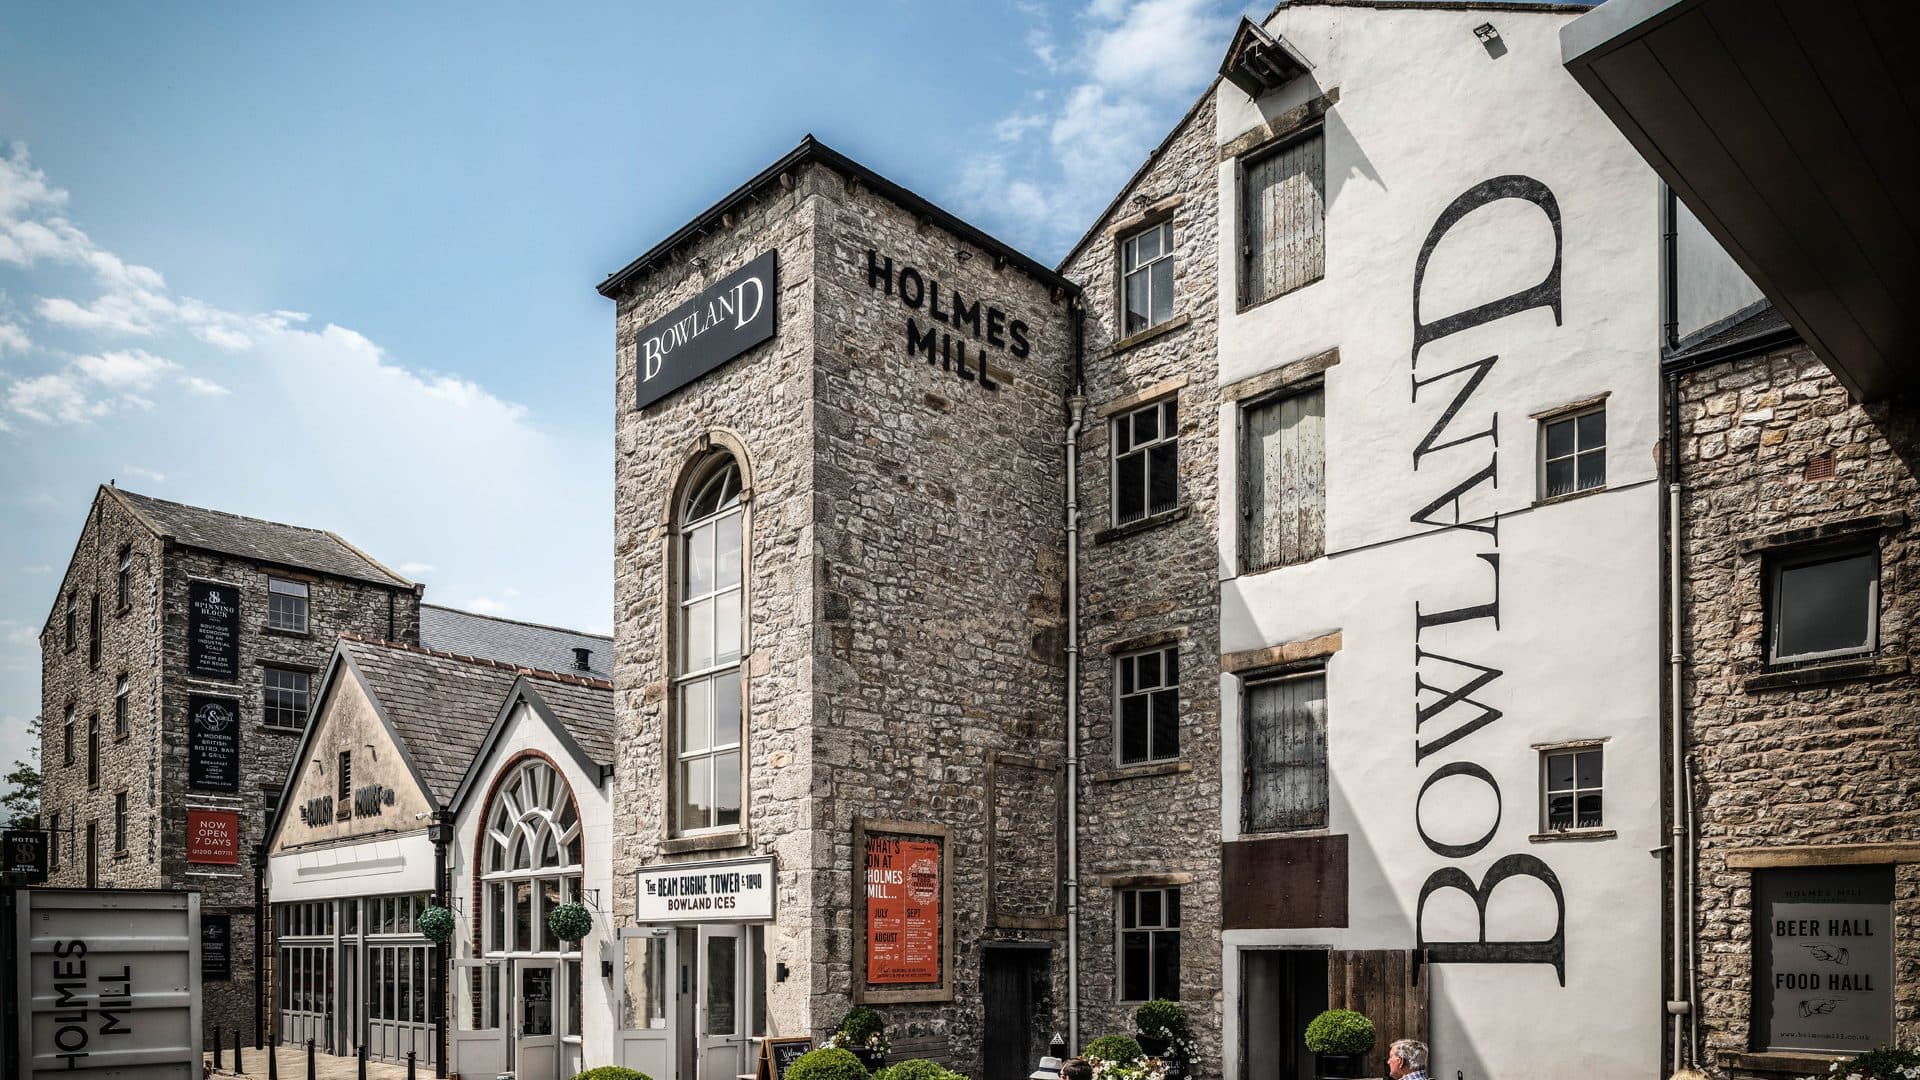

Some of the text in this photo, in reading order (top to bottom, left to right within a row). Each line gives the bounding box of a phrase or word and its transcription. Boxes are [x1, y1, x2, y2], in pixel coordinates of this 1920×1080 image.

[867, 248, 1031, 360] HOLMES
[642, 276, 764, 384] BOWLAND
[906, 317, 997, 391] MILL
[1410, 174, 1565, 988] BOWLAND
[201, 607, 228, 618] BLOCK
[200, 820, 226, 829] NOW
[11, 836, 40, 844] HOTEL
[198, 829, 228, 838] OPEN
[204, 837, 232, 847] DAYS
[867, 838, 901, 854] WHAT'S
[868, 853, 893, 869] ON AT
[657, 876, 678, 897] BEAM
[680, 874, 707, 896] ENGINE
[709, 872, 740, 895] TOWER
[867, 868, 903, 885] HOLMES
[667, 896, 736, 911] BOWLAND ICES
[874, 908, 889, 919] JULY
[906, 908, 921, 918] SEPT
[1776, 919, 1874, 937] BEER HALL
[874, 932, 898, 943] AUGUST
[1776, 973, 1875, 991] FOOD HALL
[53, 940, 90, 1072] HOLMES
[98, 965, 132, 1035] MILL
